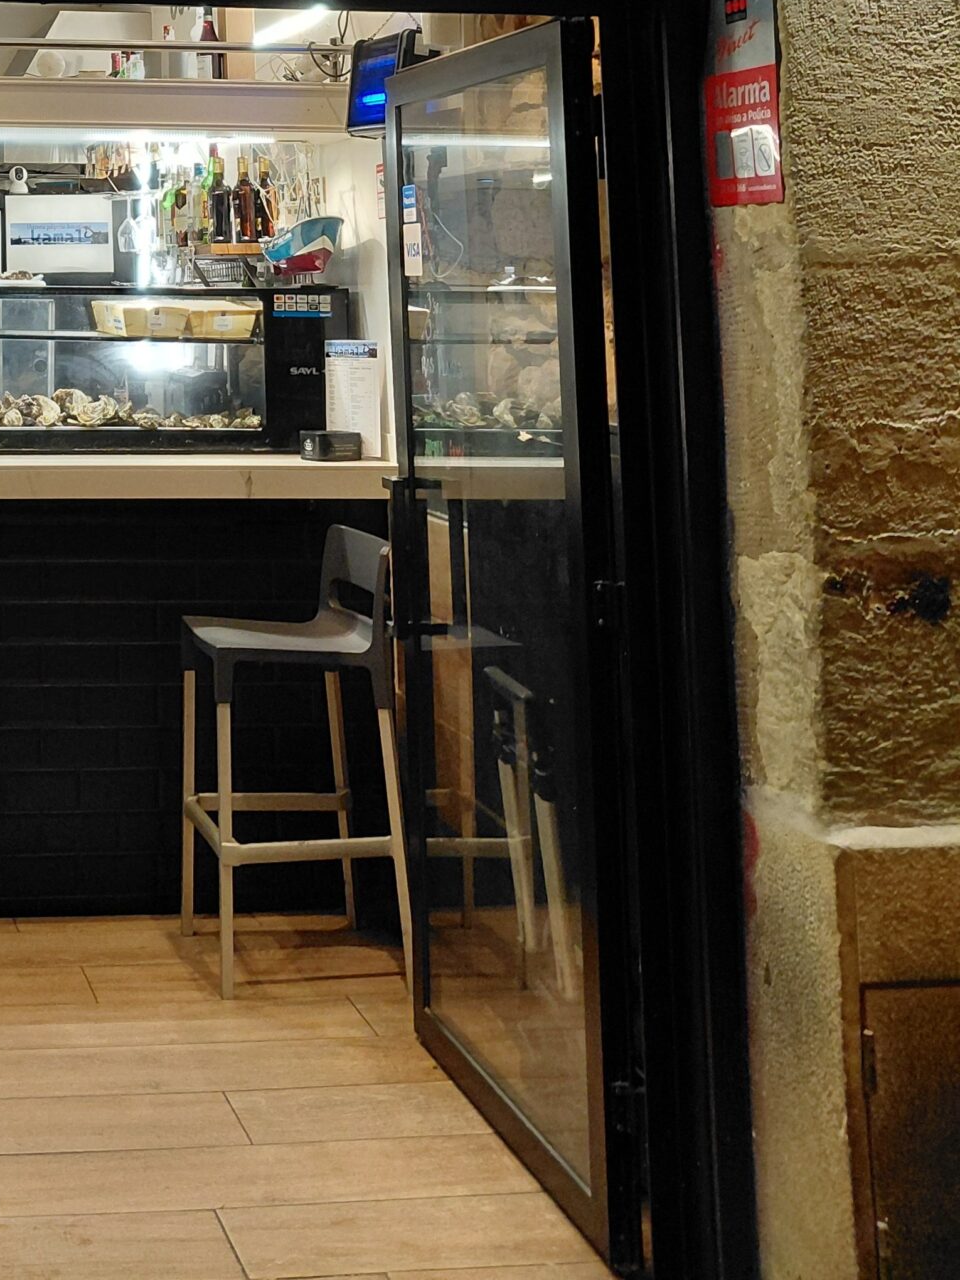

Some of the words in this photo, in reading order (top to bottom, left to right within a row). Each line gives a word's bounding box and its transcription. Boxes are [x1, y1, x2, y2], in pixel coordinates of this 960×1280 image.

[714, 79, 771, 109] Alarma
[31, 228, 81, 243] kamal
[406, 242, 421, 258] VISA
[290, 366, 320, 376] SAYL
